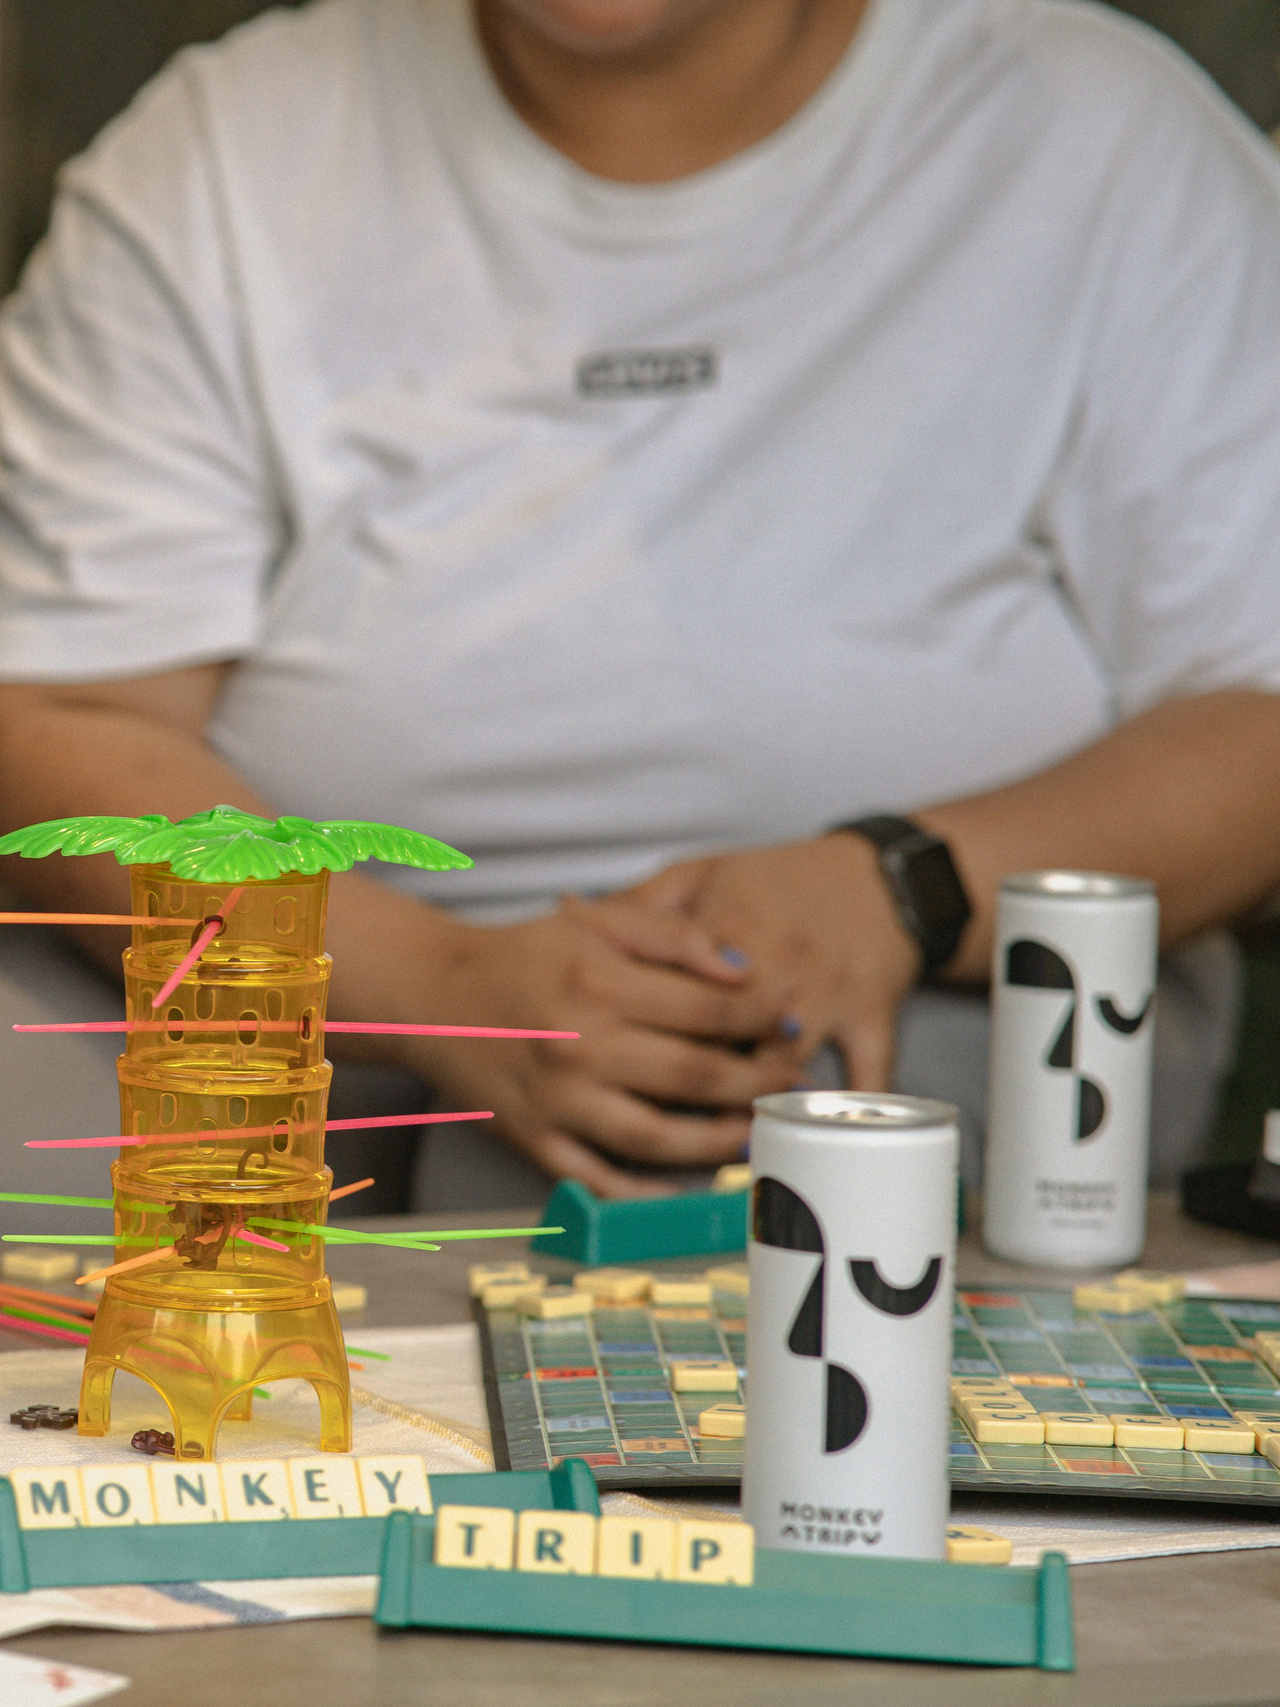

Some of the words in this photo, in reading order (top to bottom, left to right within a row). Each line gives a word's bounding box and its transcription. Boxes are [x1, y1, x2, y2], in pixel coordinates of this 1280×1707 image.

[30, 1469, 403, 1518] MONKEY
[779, 1501, 884, 1526] MONKEY
[458, 1522, 722, 1572] TRIP
[803, 1524, 858, 1546] TRIP
